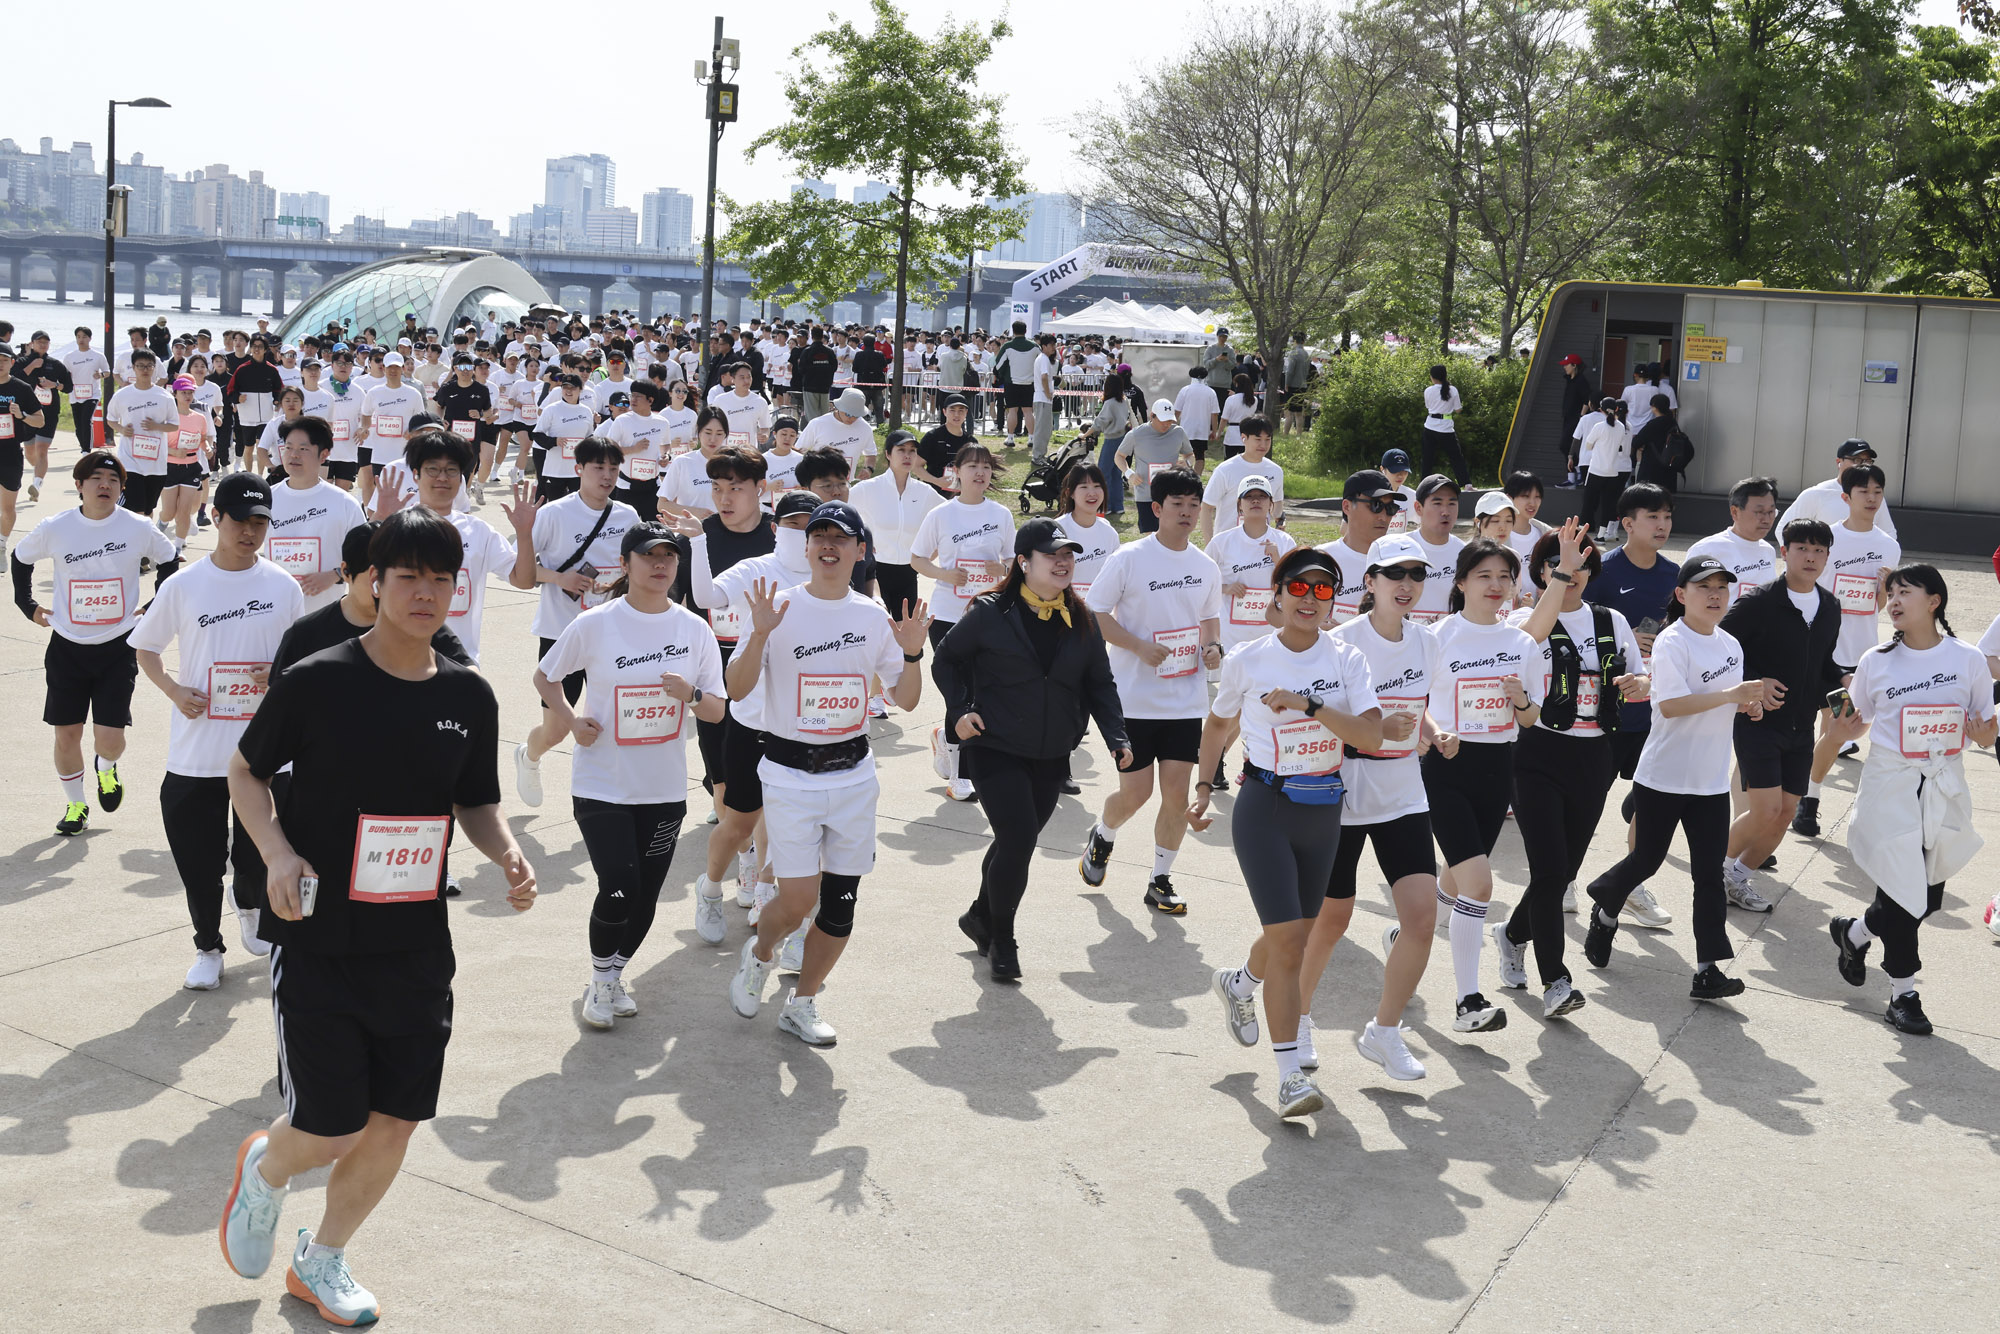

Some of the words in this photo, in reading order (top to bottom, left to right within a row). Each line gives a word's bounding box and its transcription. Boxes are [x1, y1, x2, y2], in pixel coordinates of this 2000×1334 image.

[1030, 257, 1079, 292] START
[243, 490, 264, 500] Jeep
[271, 514, 307, 530] Burning
[307, 507, 328, 519] Run
[607, 527, 625, 537] Run
[952, 529, 983, 544] Burning
[982, 523, 999, 533] Run
[64, 549, 104, 564] Burning
[104, 542, 127, 553] Run
[283, 552, 313, 562] 2451
[1834, 556, 1866, 569] Burning
[1866, 551, 1882, 561] Run
[1232, 561, 1262, 573] Burning
[1734, 561, 1760, 574] Burning
[1760, 559, 1771, 567] Run
[968, 573, 994, 583] 3256
[1149, 580, 1184, 591] Burning
[1184, 575, 1202, 585] Run
[75, 597, 83, 605] M
[84, 595, 118, 606] 2452
[1846, 589, 1874, 600] 2316
[198, 608, 245, 628] Burning
[245, 600, 274, 614] Run
[793, 640, 842, 660] Burning
[841, 632, 867, 644] Run
[1172, 644, 1197, 658] 1599
[615, 651, 663, 669] Burning
[663, 644, 690, 657] Run
[1449, 656, 1496, 673] Burning
[1496, 652, 1522, 663] Run
[1404, 668, 1424, 682] Run
[217, 685, 227, 693] M
[1311, 679, 1340, 694] Run
[1886, 681, 1931, 700] Burning
[1931, 673, 1957, 685] Run
[805, 698, 816, 706] M
[817, 696, 860, 710] 2030
[1463, 699, 1473, 708] W
[1475, 696, 1512, 710] 3207
[623, 709, 634, 718] W
[635, 705, 676, 720] 3574
[1279, 725, 1307, 735] BURNING
[1907, 726, 1918, 734] W
[1919, 723, 1958, 736] 3452
[1284, 745, 1295, 754] W
[1297, 738, 1338, 756] 3566
[1281, 764, 1304, 772] D-133
[368, 825, 403, 834] BURNING
[403, 825, 420, 833] RUN
[366, 851, 382, 863] M
[385, 847, 434, 866] 1810
